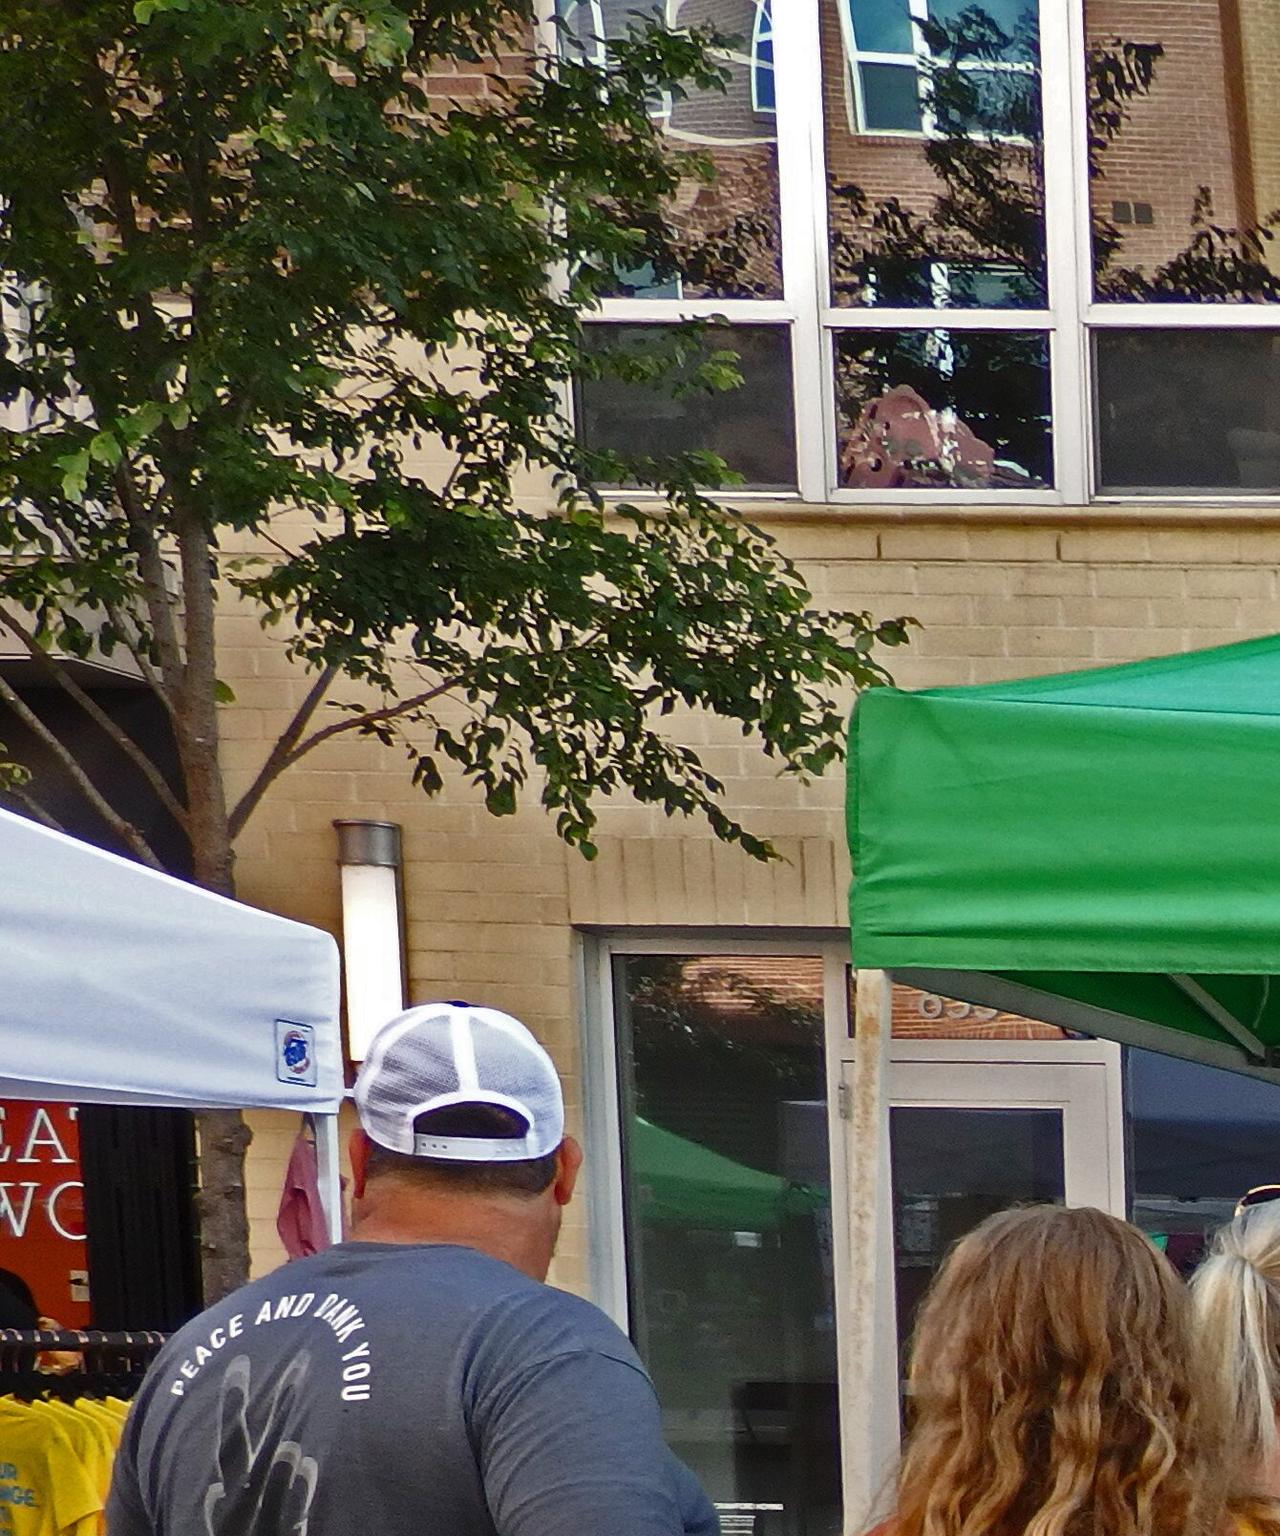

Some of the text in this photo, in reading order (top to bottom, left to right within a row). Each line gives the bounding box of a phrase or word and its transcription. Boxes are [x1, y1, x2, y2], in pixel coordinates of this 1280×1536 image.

[171, 1293, 371, 1401] PEACE AND DANK YOU
